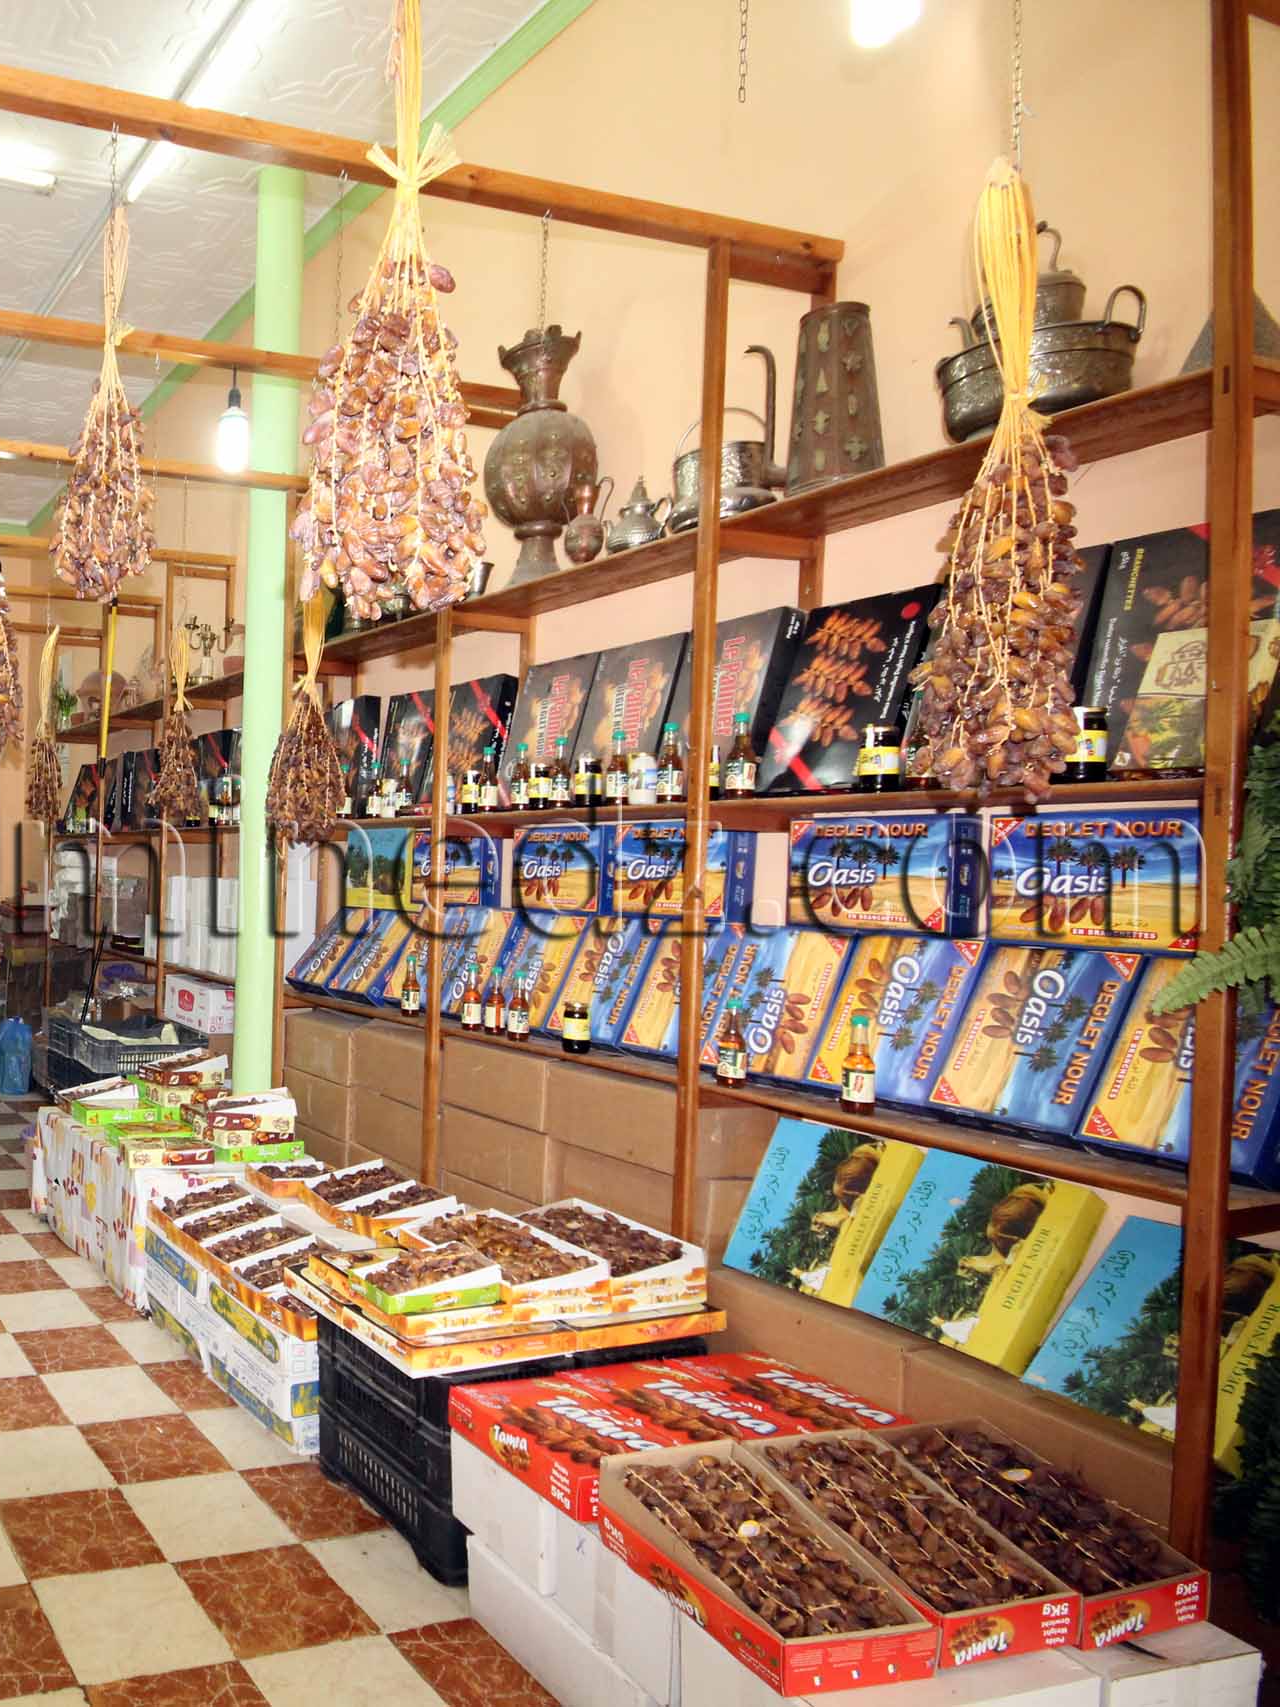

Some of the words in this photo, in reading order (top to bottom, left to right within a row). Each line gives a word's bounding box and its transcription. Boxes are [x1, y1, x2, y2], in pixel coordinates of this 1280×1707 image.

[562, 831, 590, 842] NOUR
[816, 824, 878, 839] DEGLET
[878, 823, 929, 838] NOUR
[1025, 820, 1108, 838] DEGLET
[1114, 820, 1184, 838] NOUR
[523, 860, 562, 879] Oasis
[627, 859, 678, 880] Oasis
[807, 862, 877, 887] Oasis
[1016, 867, 1111, 896] Oasis
[352, 940, 380, 981] Oasis
[524, 959, 544, 1001] asis
[594, 932, 625, 986] Oasis
[735, 943, 760, 985] NOUR
[879, 955, 921, 1026] Oasis
[931, 965, 969, 1030] DEGLET
[1015, 969, 1065, 1045] Oasis
[748, 989, 785, 1054] Oasis
[1077, 980, 1120, 1050] DEGLET
[911, 1031, 944, 1081] NOUR
[1108, 1036, 1142, 1101] BRANCHETTES
[1051, 1052, 1092, 1105] NOUR
[1231, 1078, 1269, 1140] NOUR
[1002, 1260, 1033, 1311] DEGLET
[1030, 1227, 1051, 1262] NOUR
[1221, 1343, 1256, 1395] DEGLET
[1253, 1303, 1280, 1344] NOUR
[643, 1379, 778, 1435] Tamra
[755, 1369, 897, 1425] Tamra
[492, 1424, 529, 1451] Tamra
[535, 1395, 664, 1451] Tamra
[550, 1485, 571, 1510] 5Kg
[1041, 1602, 1070, 1617] 5Kg
[1176, 1581, 1200, 1597] 5Kg
[953, 1630, 1009, 1667] Tamra
[1094, 1611, 1145, 1648] Tamra
